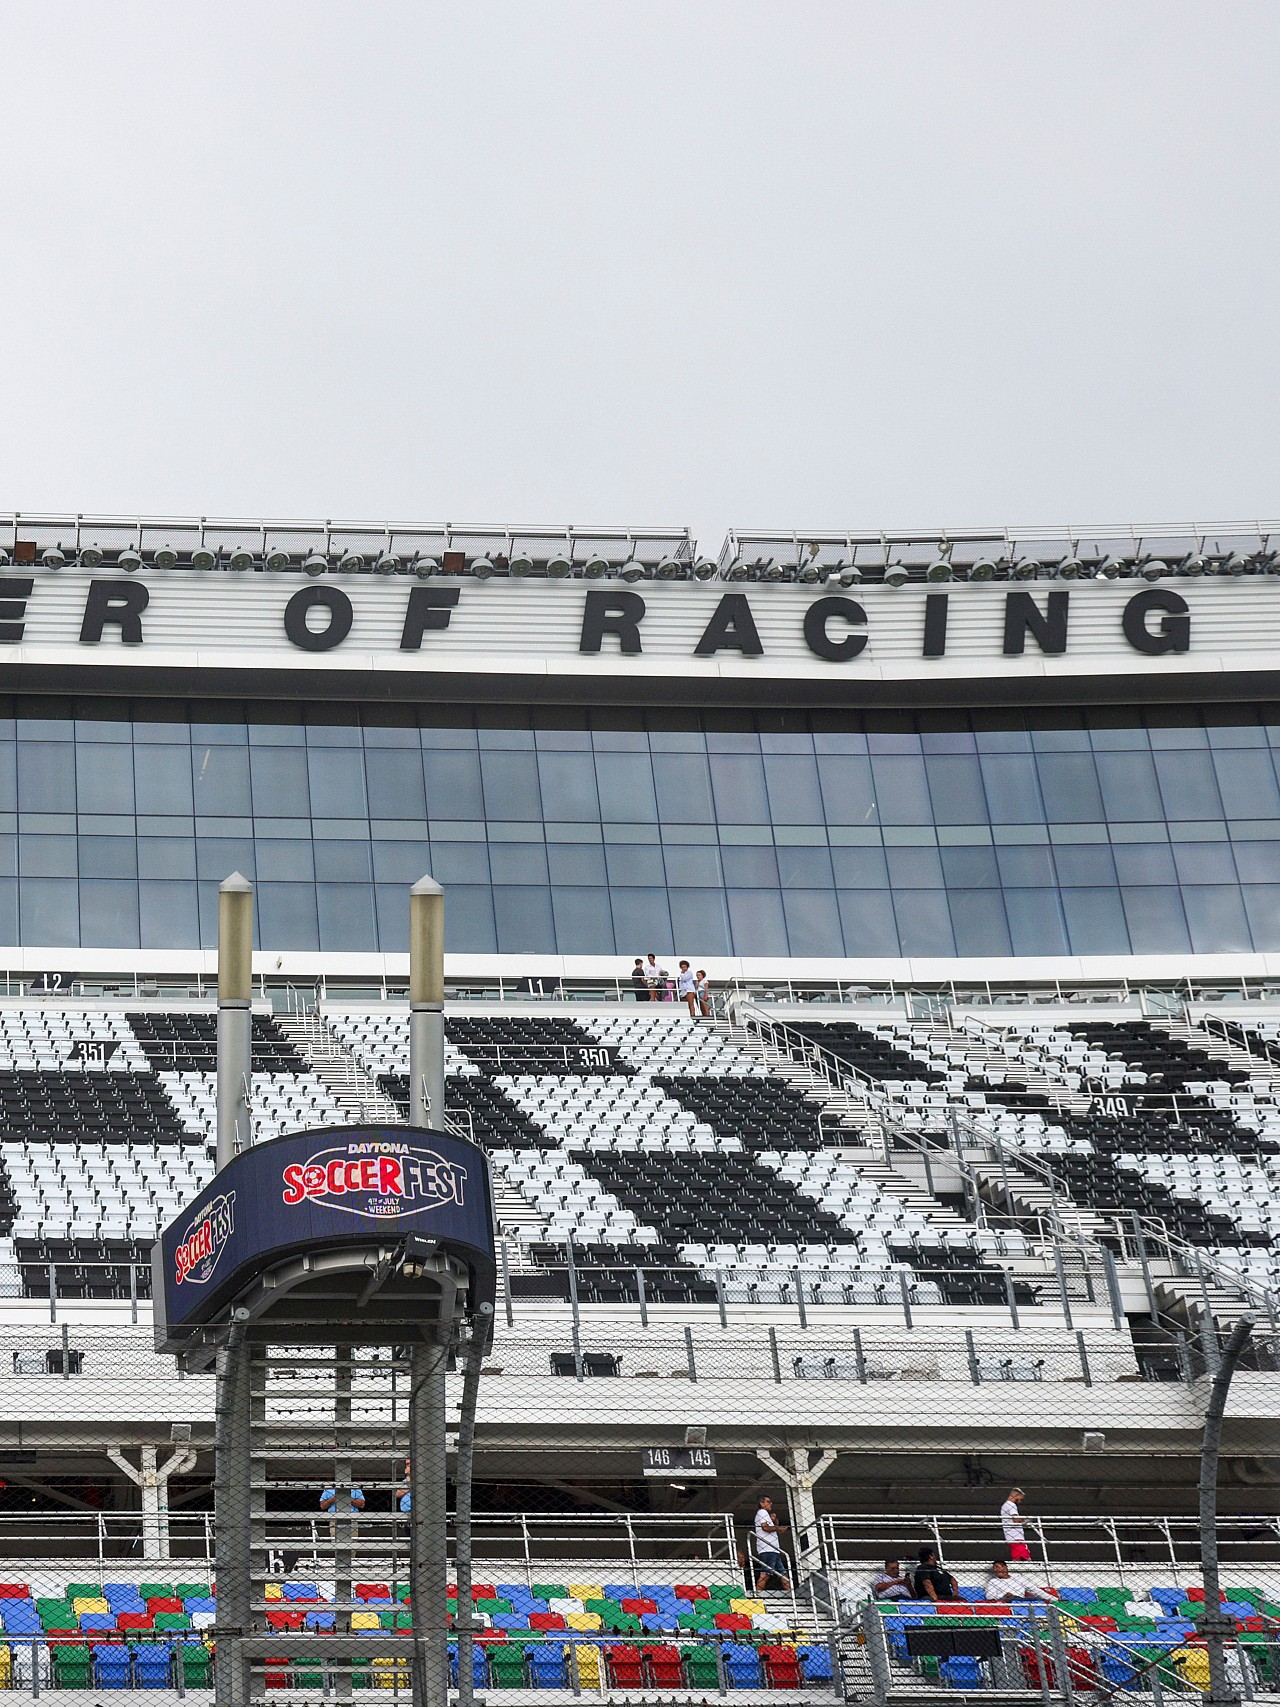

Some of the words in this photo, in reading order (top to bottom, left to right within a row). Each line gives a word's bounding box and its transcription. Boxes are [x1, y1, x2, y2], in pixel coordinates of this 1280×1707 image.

[283, 586, 460, 652] OF
[579, 589, 1191, 663] RACING
[43, 973, 63, 992] L2
[527, 978, 544, 997] L1
[78, 1042, 106, 1061] 351
[578, 1048, 610, 1066] 350
[1093, 1096, 1129, 1117] 349
[347, 1142, 411, 1155] DAYTONA
[368, 1205, 401, 1215] WEEKEND
[383, 1197, 400, 1205] JULY
[647, 1448, 671, 1466] 146
[688, 1449, 711, 1466] 145
